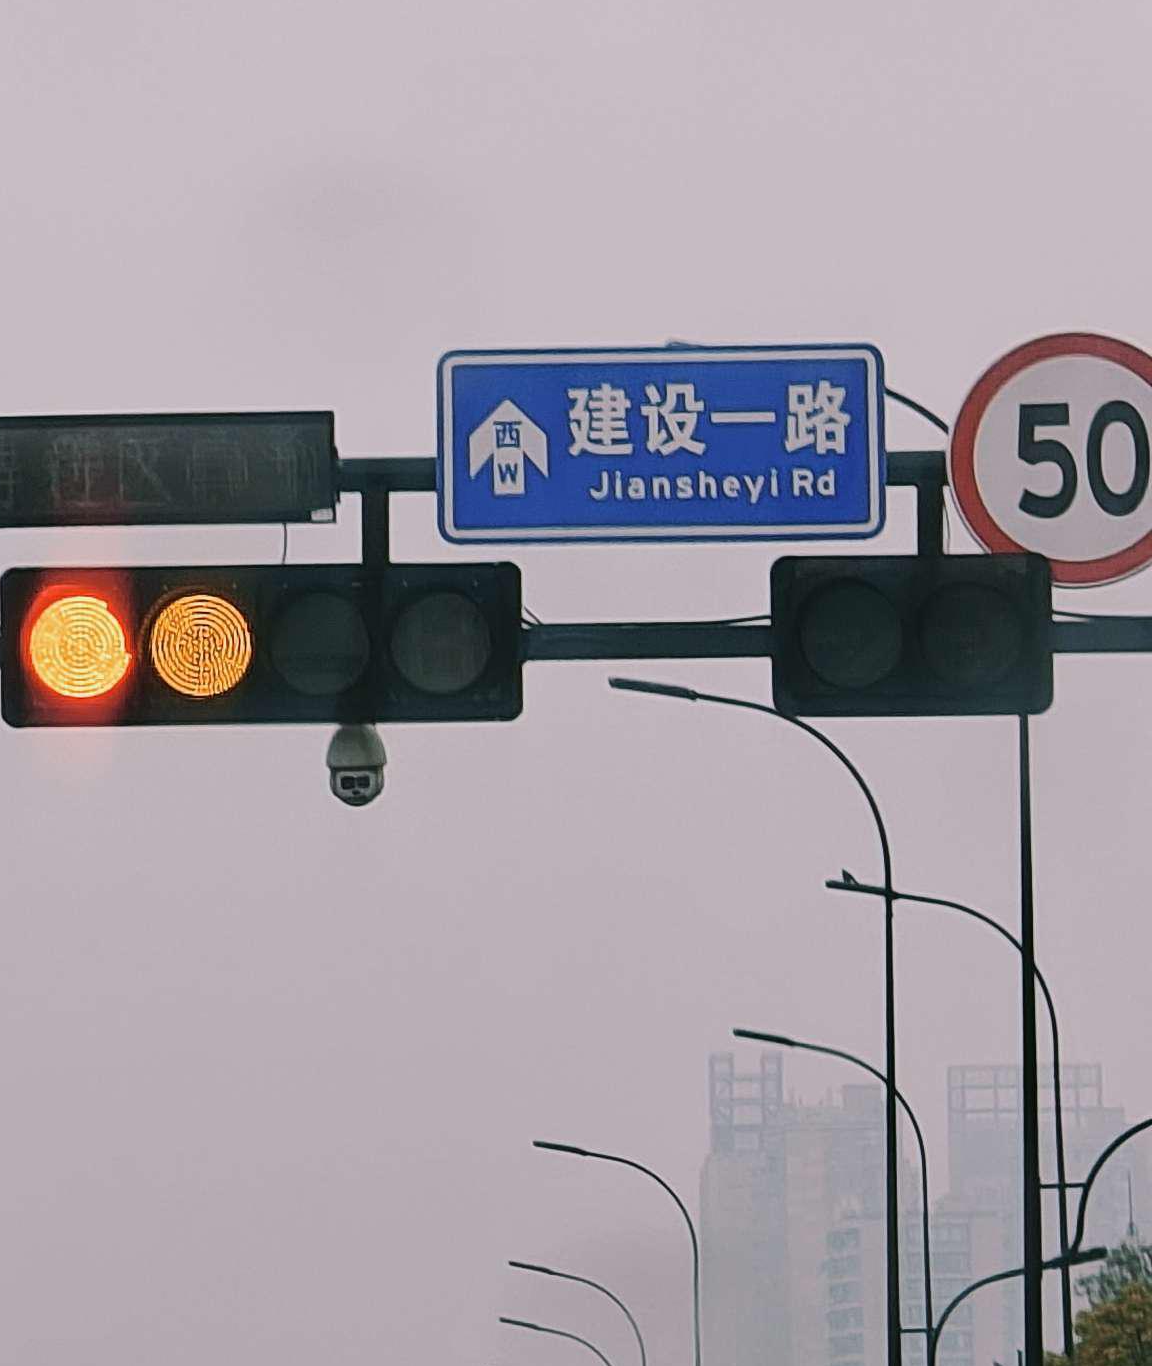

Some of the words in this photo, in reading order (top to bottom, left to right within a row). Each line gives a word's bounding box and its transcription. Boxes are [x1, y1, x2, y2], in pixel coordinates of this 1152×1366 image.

[493, 420, 522, 449] 西
[567, 380, 851, 457] 建设一路
[498, 462, 520, 484] W
[1017, 399, 1151, 519] 50
[589, 467, 779, 503] Jiansheyi
[792, 468, 836, 497] Rd
